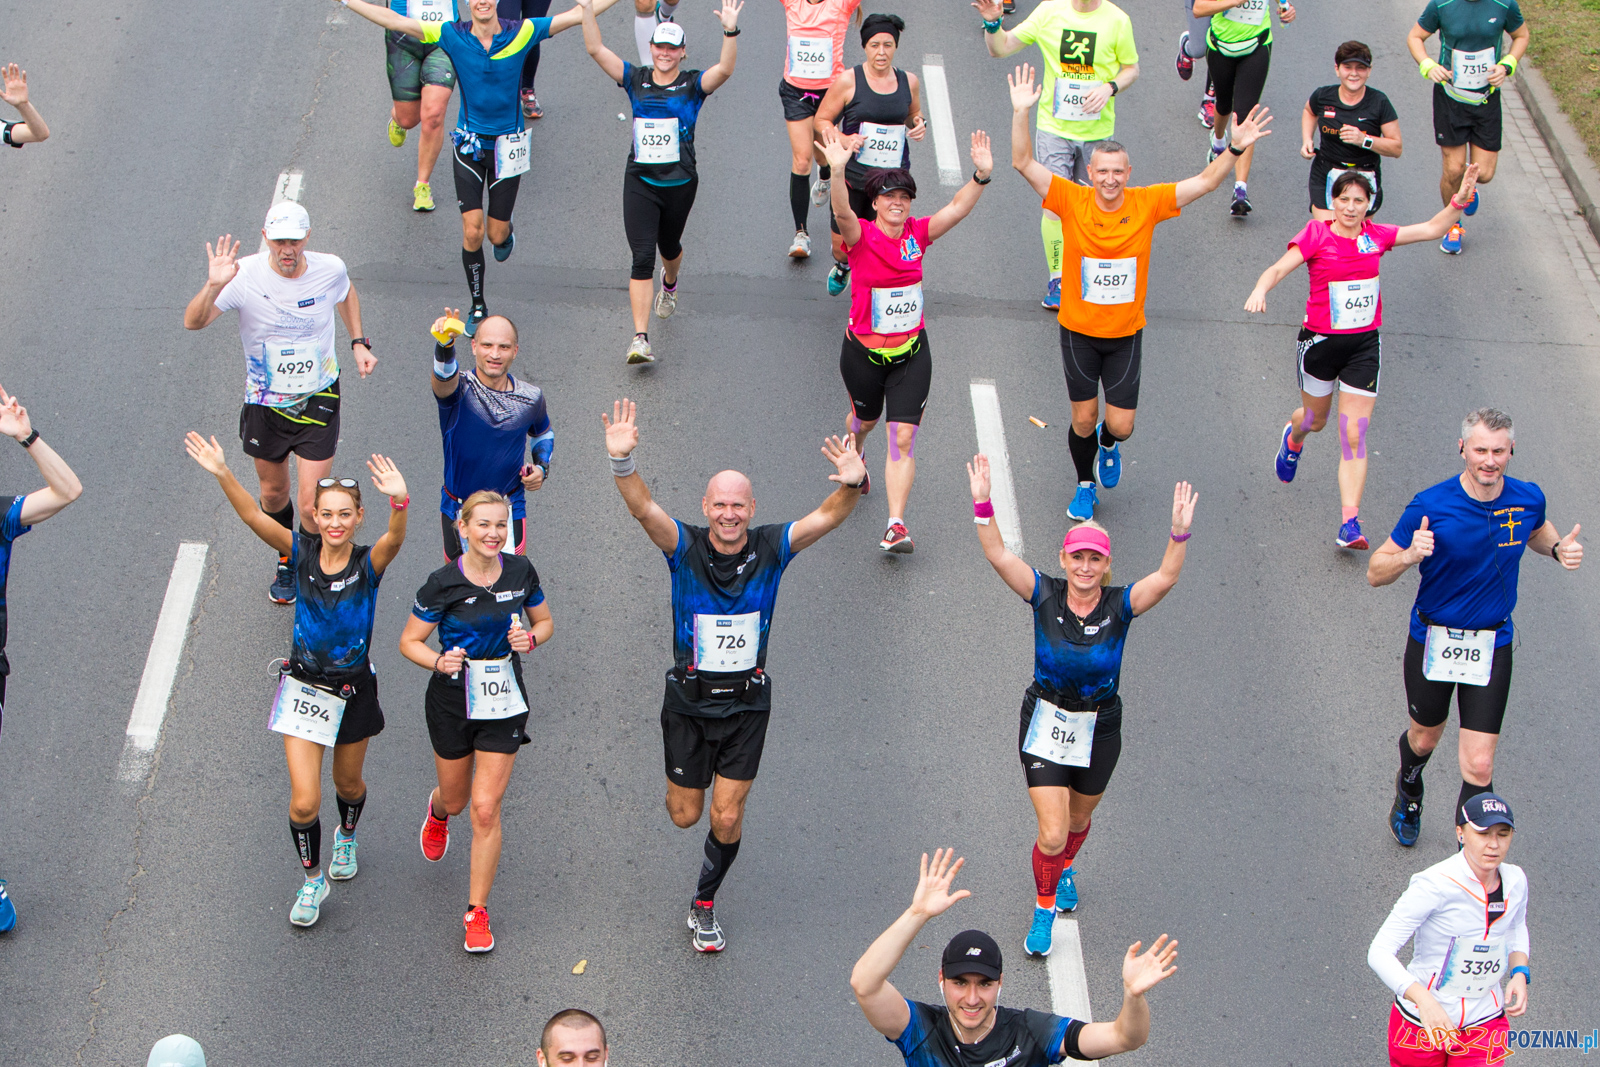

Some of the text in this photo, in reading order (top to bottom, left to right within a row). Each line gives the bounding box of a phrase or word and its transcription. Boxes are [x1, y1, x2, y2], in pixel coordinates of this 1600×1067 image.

[421, 12, 443, 22] 802
[797, 52, 825, 63] 5266
[1067, 64, 1089, 73] night
[1462, 63, 1488, 74] 7315
[1063, 94, 1088, 105] 480
[641, 134, 671, 146] 6329
[868, 139, 898, 152] 2842
[508, 147, 527, 160] 6116
[1093, 274, 1128, 287] 4587
[885, 300, 918, 316] 6426
[1345, 294, 1374, 310] 6431
[276, 359, 314, 375] 4929
[716, 634, 746, 649] 726
[1442, 646, 1481, 663] 6918
[293, 698, 330, 723] 1594
[1051, 725, 1077, 745] 814
[1482, 802, 1508, 814] RUN
[1460, 958, 1501, 976] 3396
